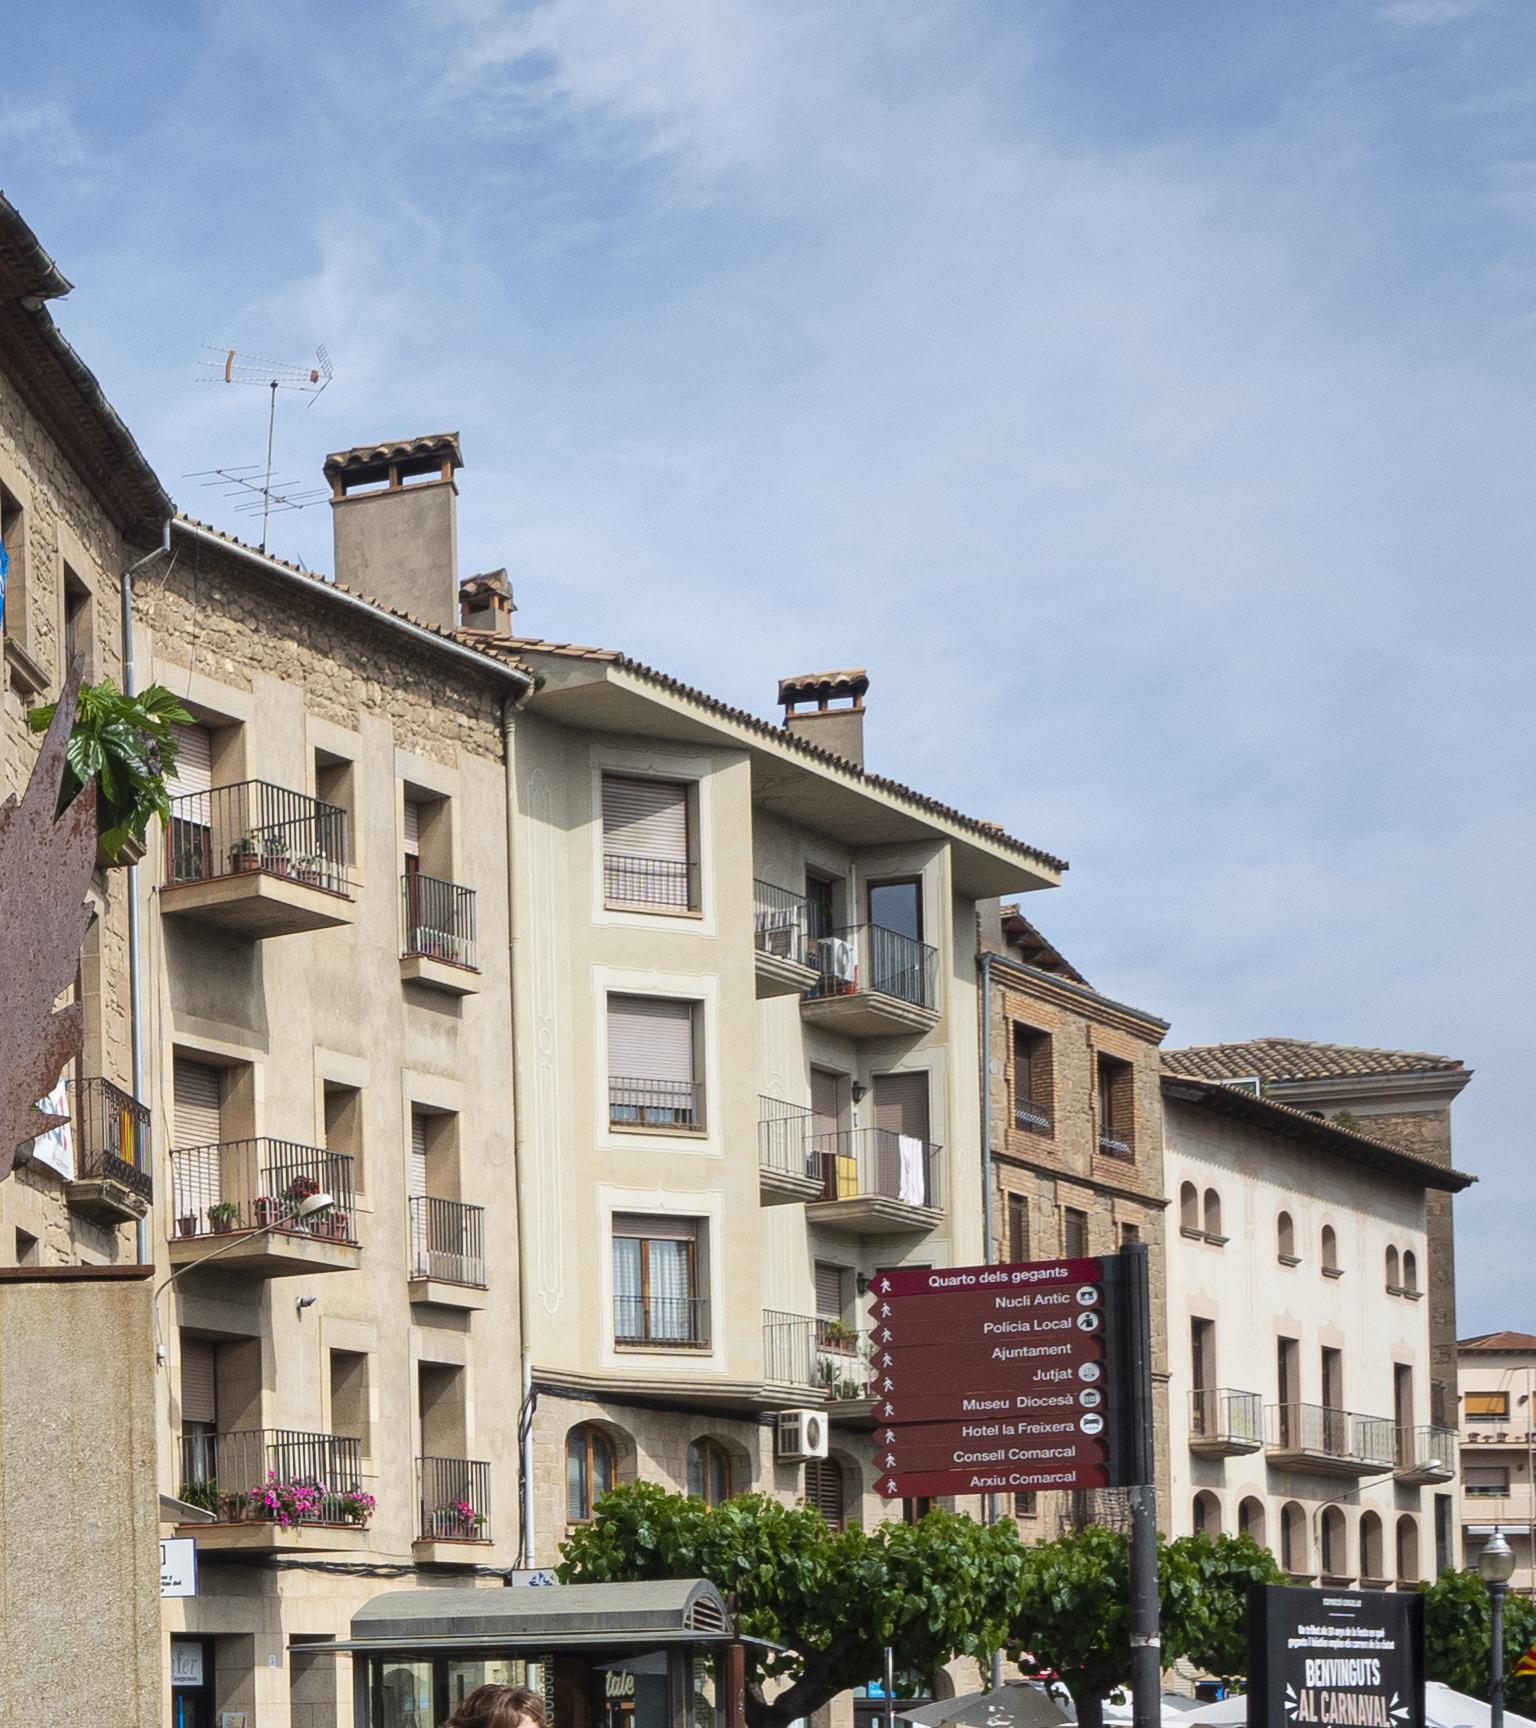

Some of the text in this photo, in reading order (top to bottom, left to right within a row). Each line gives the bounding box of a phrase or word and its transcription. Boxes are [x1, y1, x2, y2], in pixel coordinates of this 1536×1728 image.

[928, 1266, 1068, 1288] Quarto dels gegants
[995, 1291, 1070, 1309] Nucli Antic
[983, 1317, 1072, 1335] Policia Local
[991, 1343, 1072, 1361] Ajuntament
[1032, 1368, 1073, 1383] Jutjat
[962, 1392, 1074, 1412] Museu Diocesà
[962, 1420, 1075, 1438] Hotel la Freixera
[953, 1445, 1076, 1464] Consell Comarcal
[970, 1471, 1076, 1488] Arxiu Comarcal
[1305, 1658, 1381, 1687] BENVINGUTS
[1298, 1689, 1391, 1728] AL CARNAVAL
